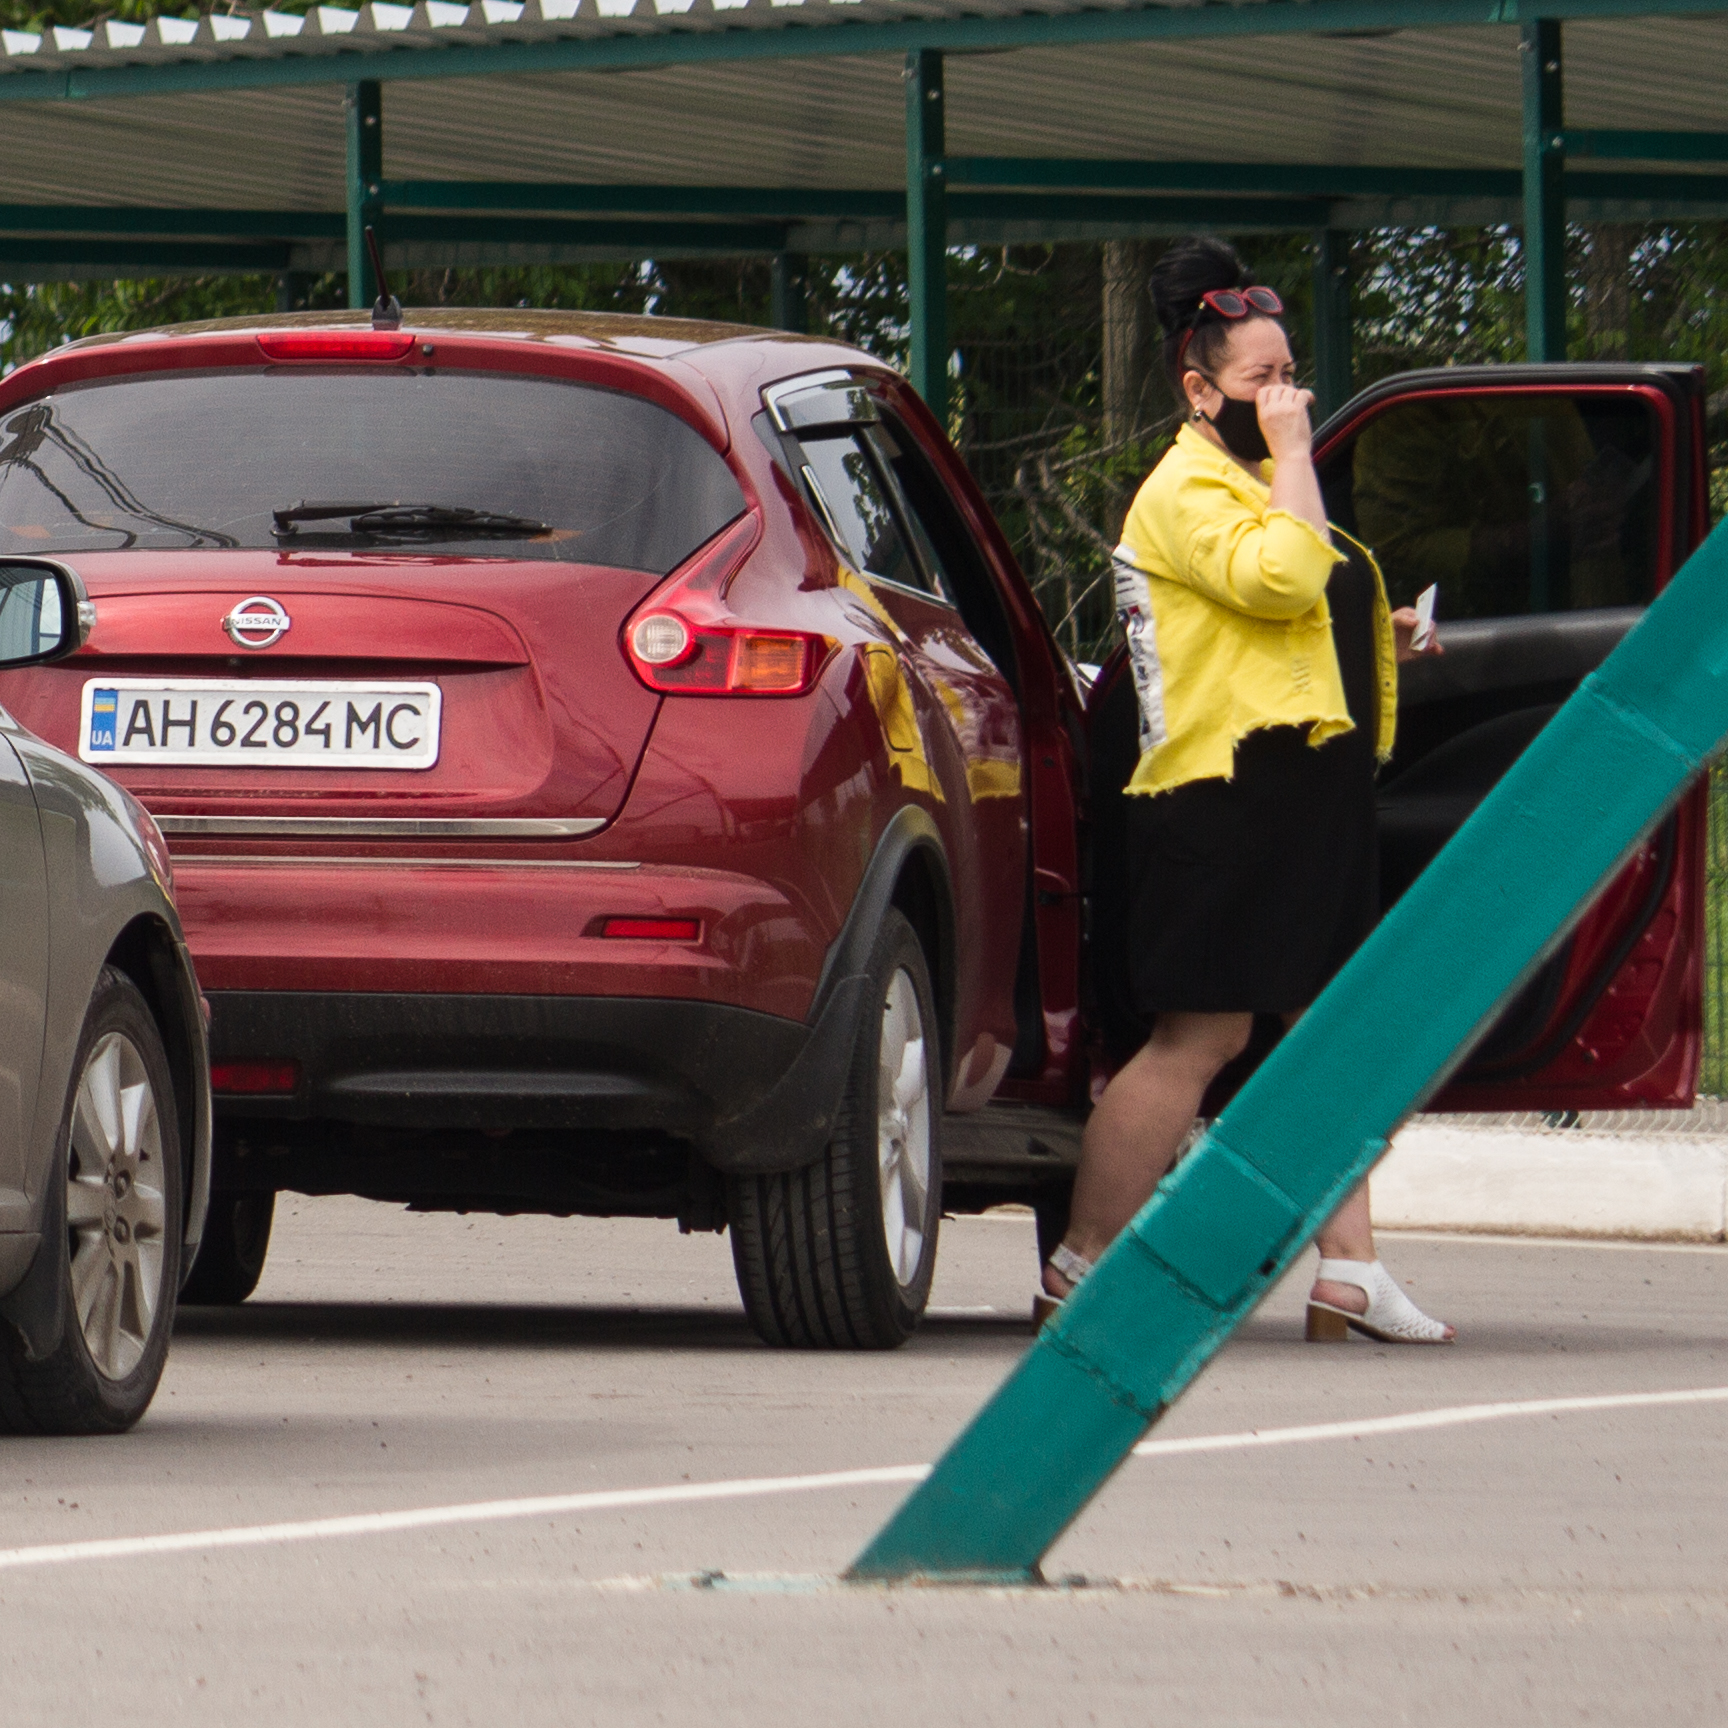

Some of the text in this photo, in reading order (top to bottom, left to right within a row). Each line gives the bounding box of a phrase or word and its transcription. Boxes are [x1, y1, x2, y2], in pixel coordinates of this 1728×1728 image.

[230, 616, 282, 627] NISSAN
[122, 698, 422, 751] AH 6284 MC
[91, 729, 114, 747] UA
